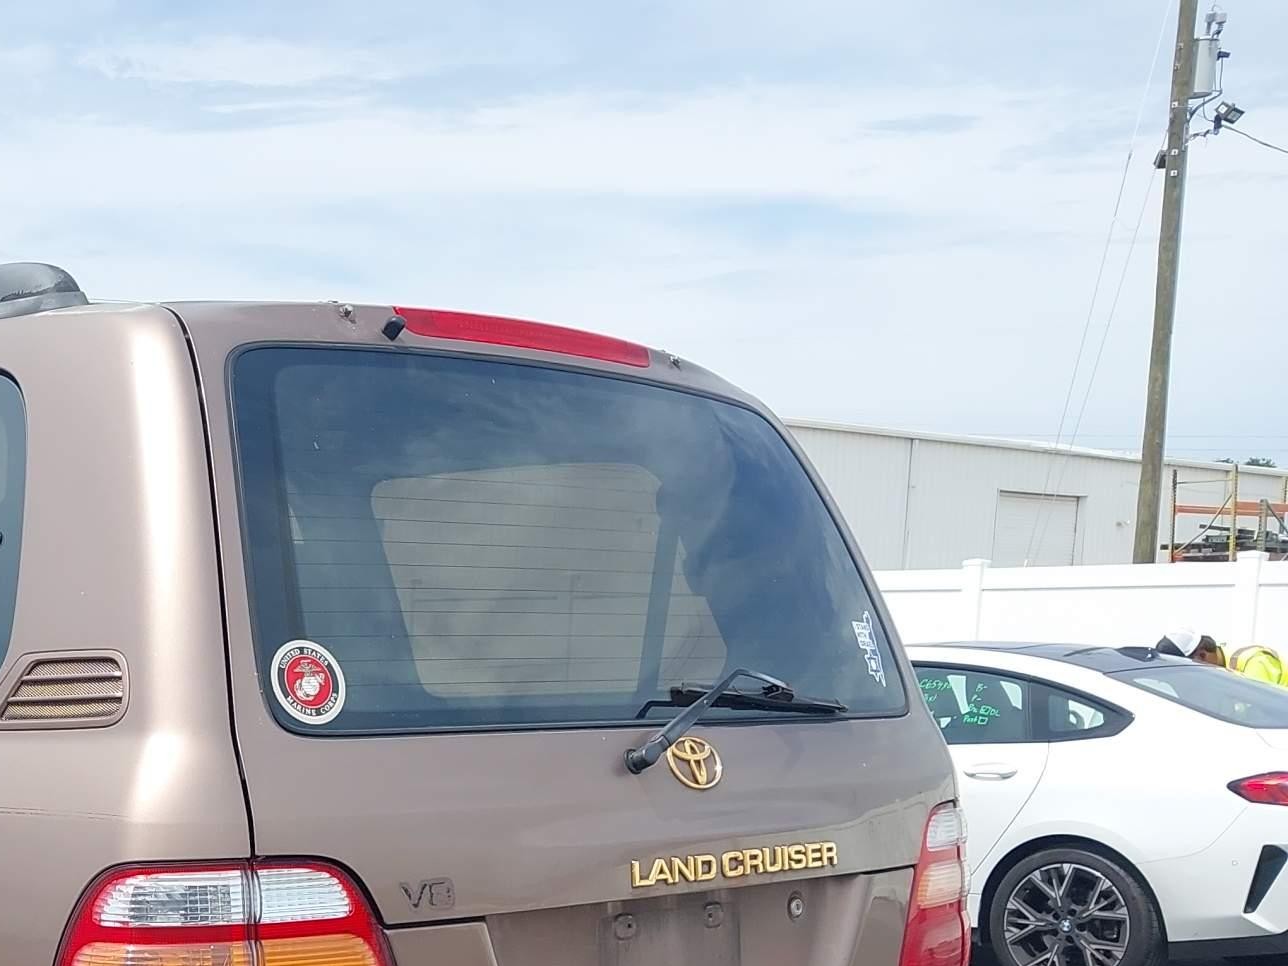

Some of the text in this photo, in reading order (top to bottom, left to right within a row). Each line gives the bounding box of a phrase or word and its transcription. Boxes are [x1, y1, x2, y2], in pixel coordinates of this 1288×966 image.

[279, 648, 329, 669] UNITED STATES
[286, 692, 338, 716] MARINE CORPS
[631, 841, 839, 889] LAND CRUISER
